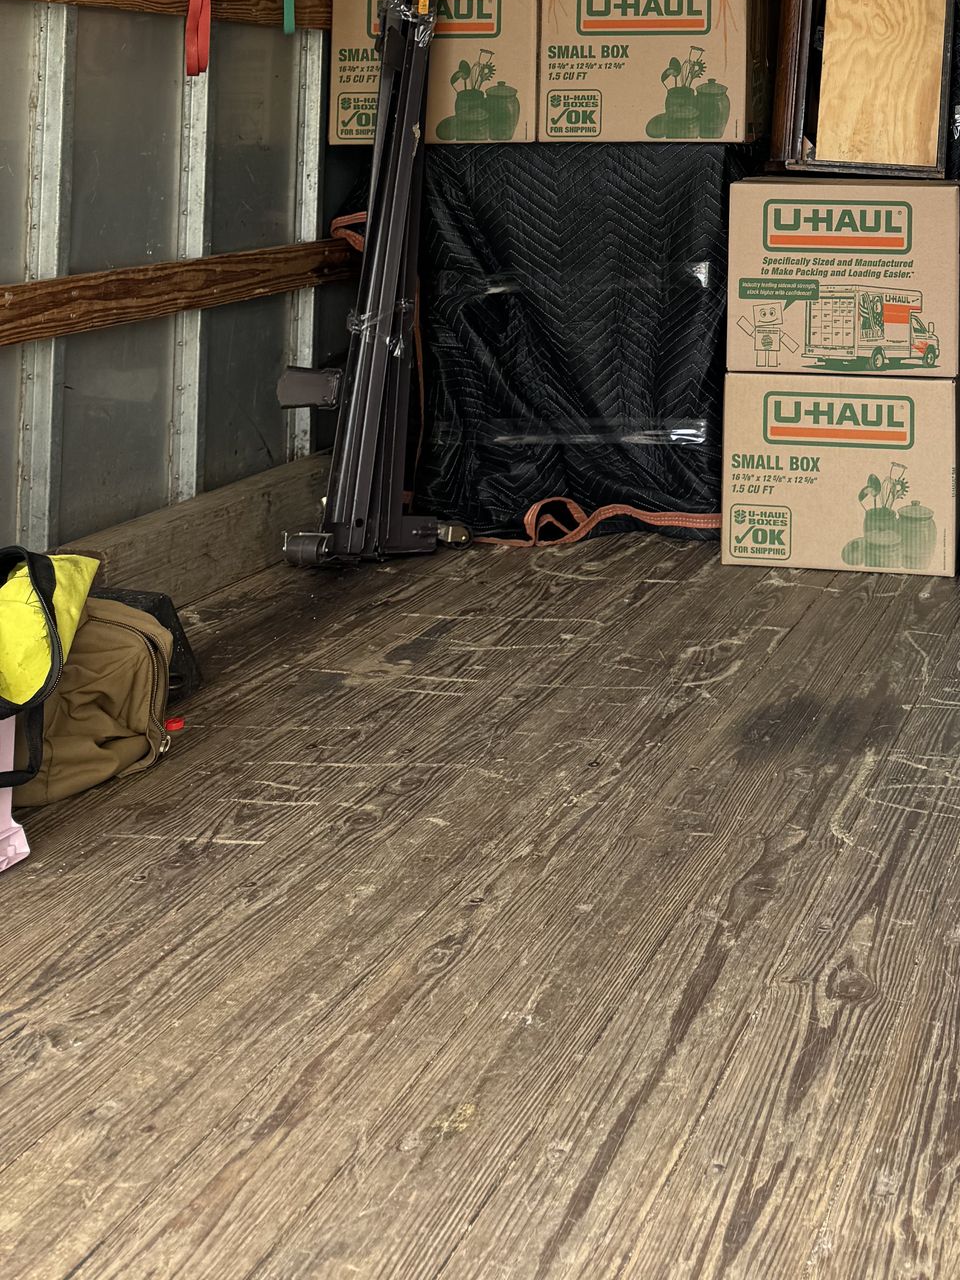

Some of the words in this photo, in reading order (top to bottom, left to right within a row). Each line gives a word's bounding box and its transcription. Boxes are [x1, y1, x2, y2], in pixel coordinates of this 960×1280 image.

[547, 45, 596, 59] SMALL
[601, 44, 629, 59] BOX
[339, 75, 351, 83] 1.5
[353, 74, 365, 83] CU
[366, 74, 378, 83] FT
[548, 72, 561, 80] 1.5
[563, 72, 575, 80] CU
[576, 72, 587, 80] FT
[566, 110, 597, 124] OK
[773, 208, 902, 233] U-HAUL
[762, 256, 811, 267] Specifically
[812, 257, 836, 266] Sized
[837, 258, 853, 267] and
[854, 258, 914, 268] Manufactured
[760, 267, 769, 275] to
[771, 267, 794, 276] Make
[795, 268, 829, 278] Packing
[830, 269, 846, 277] and
[848, 269, 881, 279] Loading
[885, 295, 911, 304] U-HAUL
[773, 400, 904, 428] U-HAUL
[731, 453, 784, 470] SMALL
[789, 456, 821, 472] BOX
[731, 473, 740, 481] 16
[731, 484, 745, 493] 1.5
[747, 484, 760, 494] CU
[762, 485, 775, 495] FT
[748, 510, 788, 519] U-HAUL
[748, 518, 788, 526] BOXES
[752, 528, 785, 546] OK
[733, 545, 749, 554] FOR
[750, 546, 786, 555] SHIPPING
